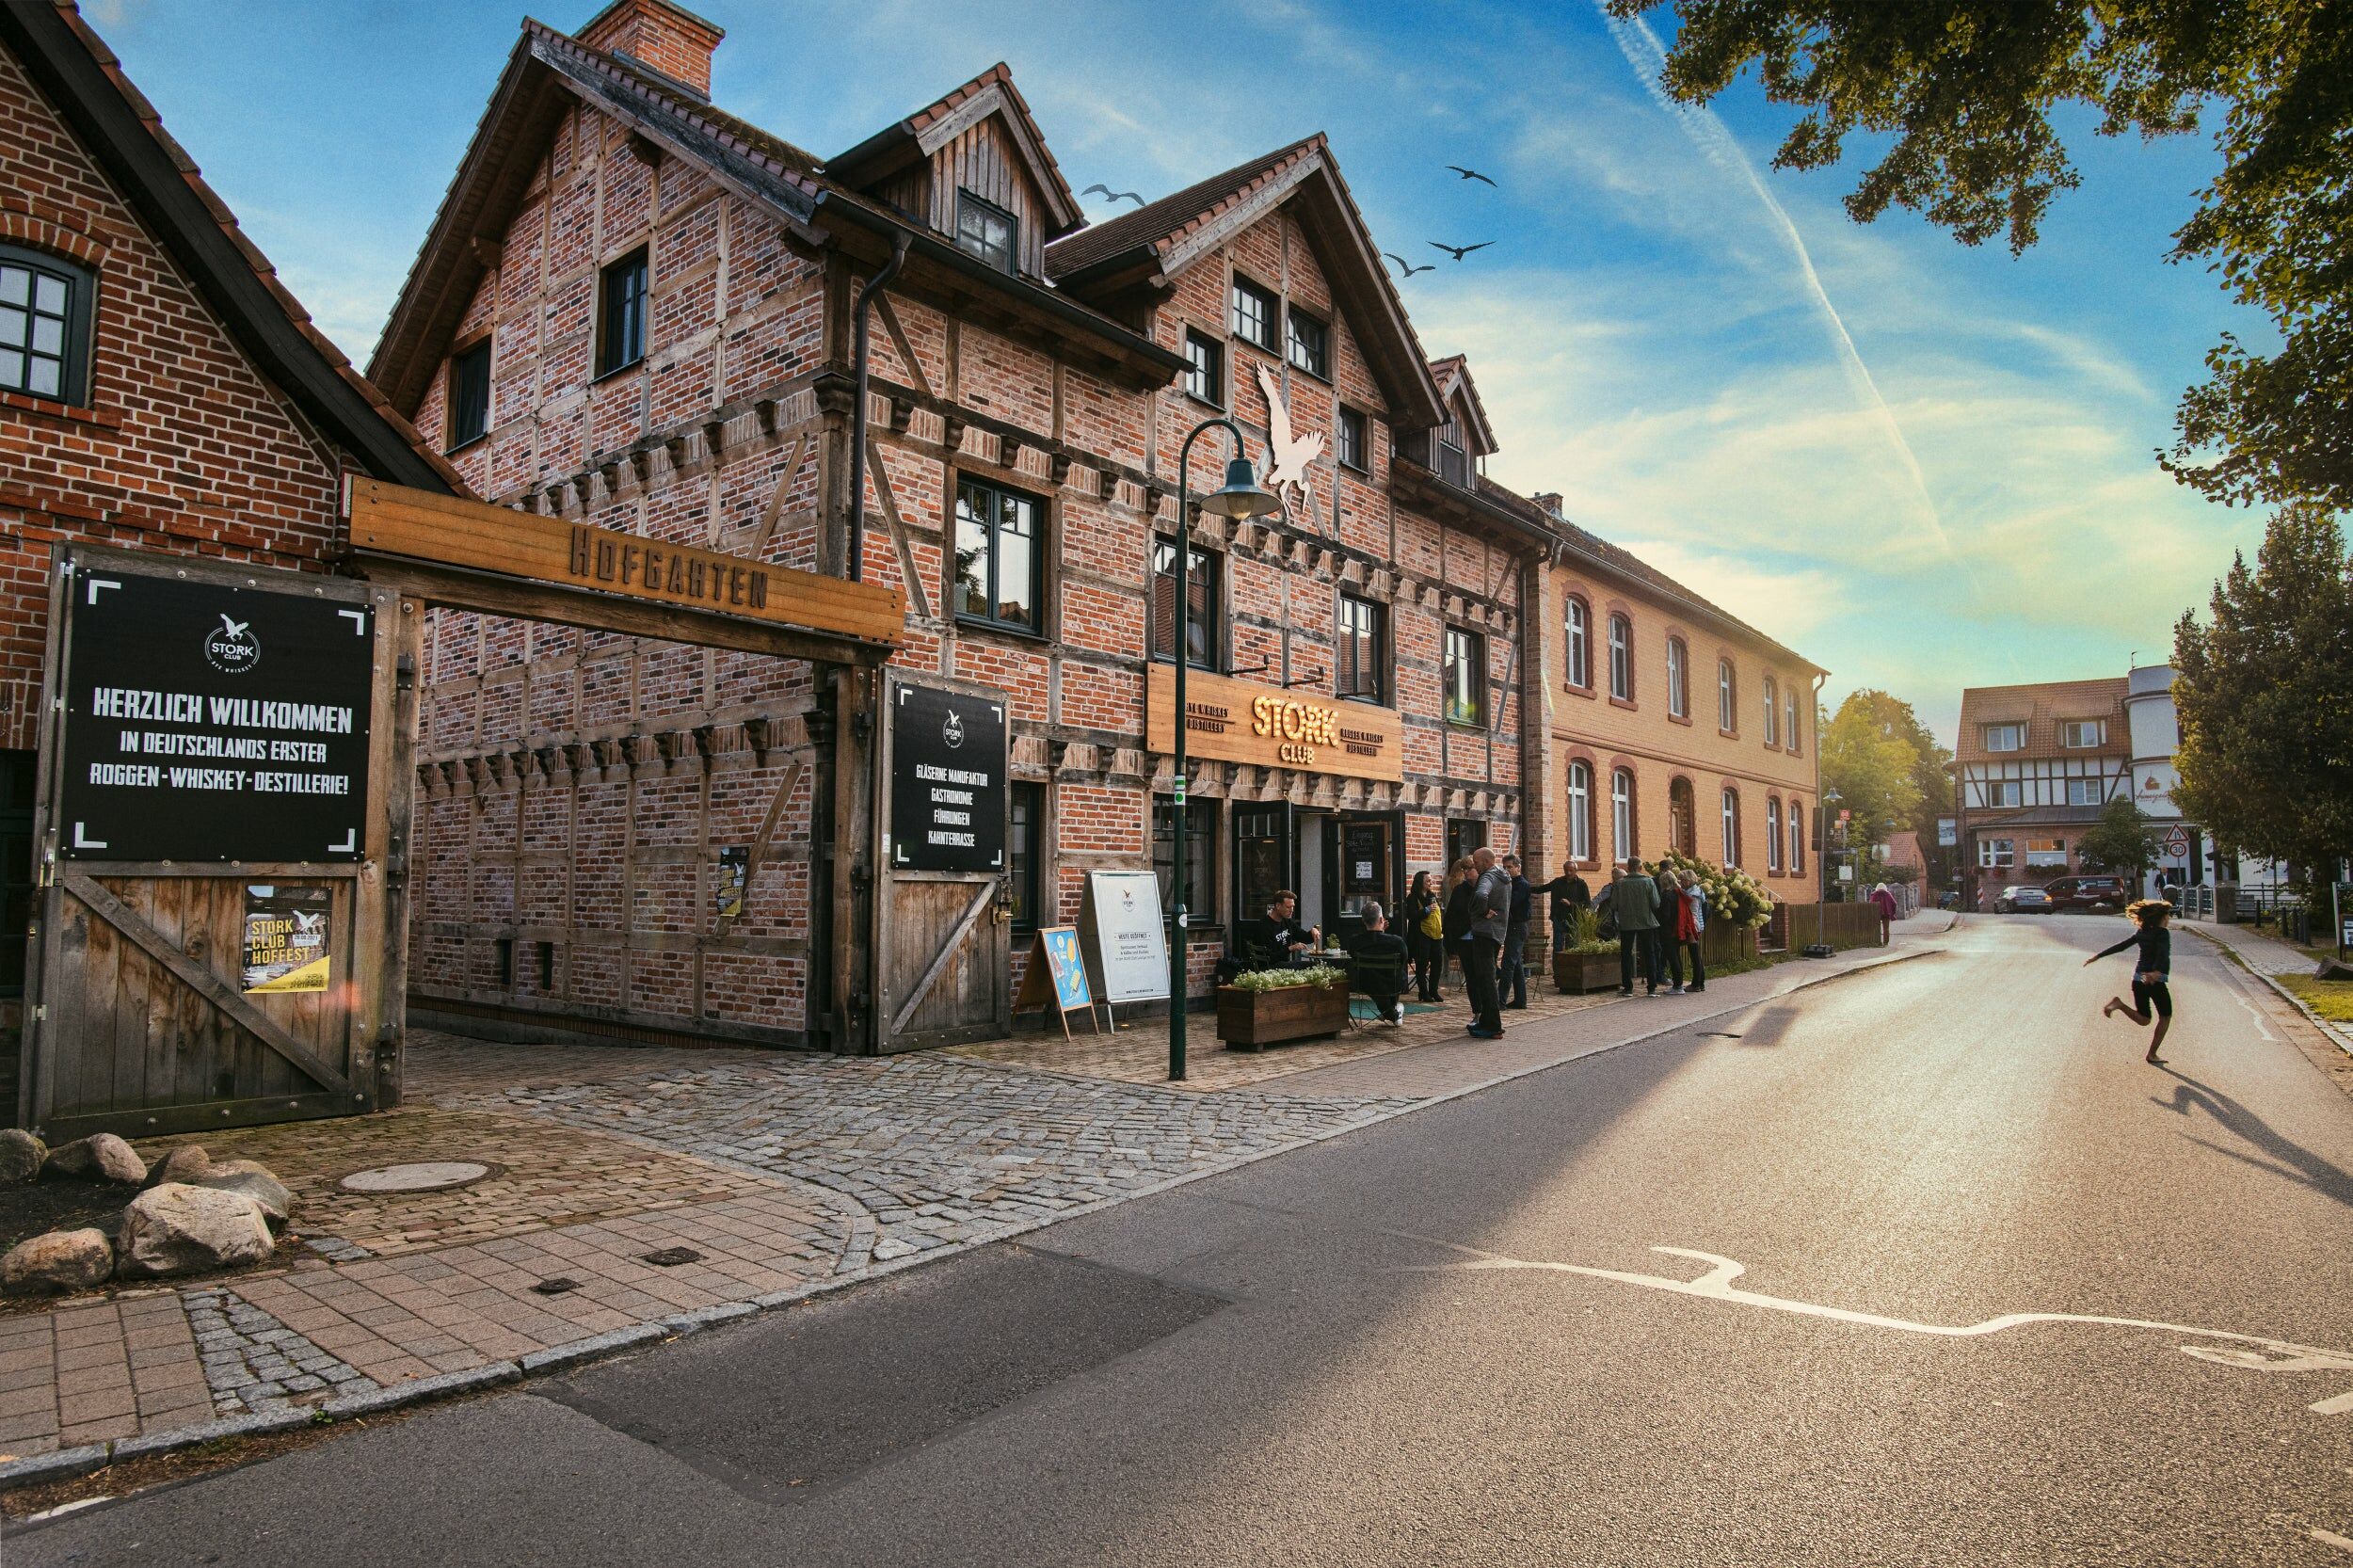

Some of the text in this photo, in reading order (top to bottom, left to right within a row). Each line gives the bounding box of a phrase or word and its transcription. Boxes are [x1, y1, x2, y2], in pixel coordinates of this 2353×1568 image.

[571, 526, 768, 608] HOFGARTEN
[211, 642, 254, 657] STORK
[93, 686, 353, 734] HERZLICH WILLKOMMEN
[1198, 703, 1229, 717] WHISKEY
[1187, 718, 1225, 733] DISTILLERY
[1252, 696, 1338, 747] STORK
[120, 730, 327, 763] IN DEUTSCHLANDS ERSTER
[1279, 743, 1315, 764] CLUB
[89, 762, 349, 795] ROGGEN-WHISKEY-DESTILLERIE!
[916, 763, 988, 787] GLÄSERNE MANUFAKTUR
[931, 788, 973, 806] GASTRONOMIE
[934, 808, 970, 826] FÜHRUNGEN
[928, 830, 975, 847] KAHNTERRASSE
[251, 919, 294, 935] STORK
[252, 935, 285, 950] CLUB
[252, 947, 311, 964] HOFFEST
